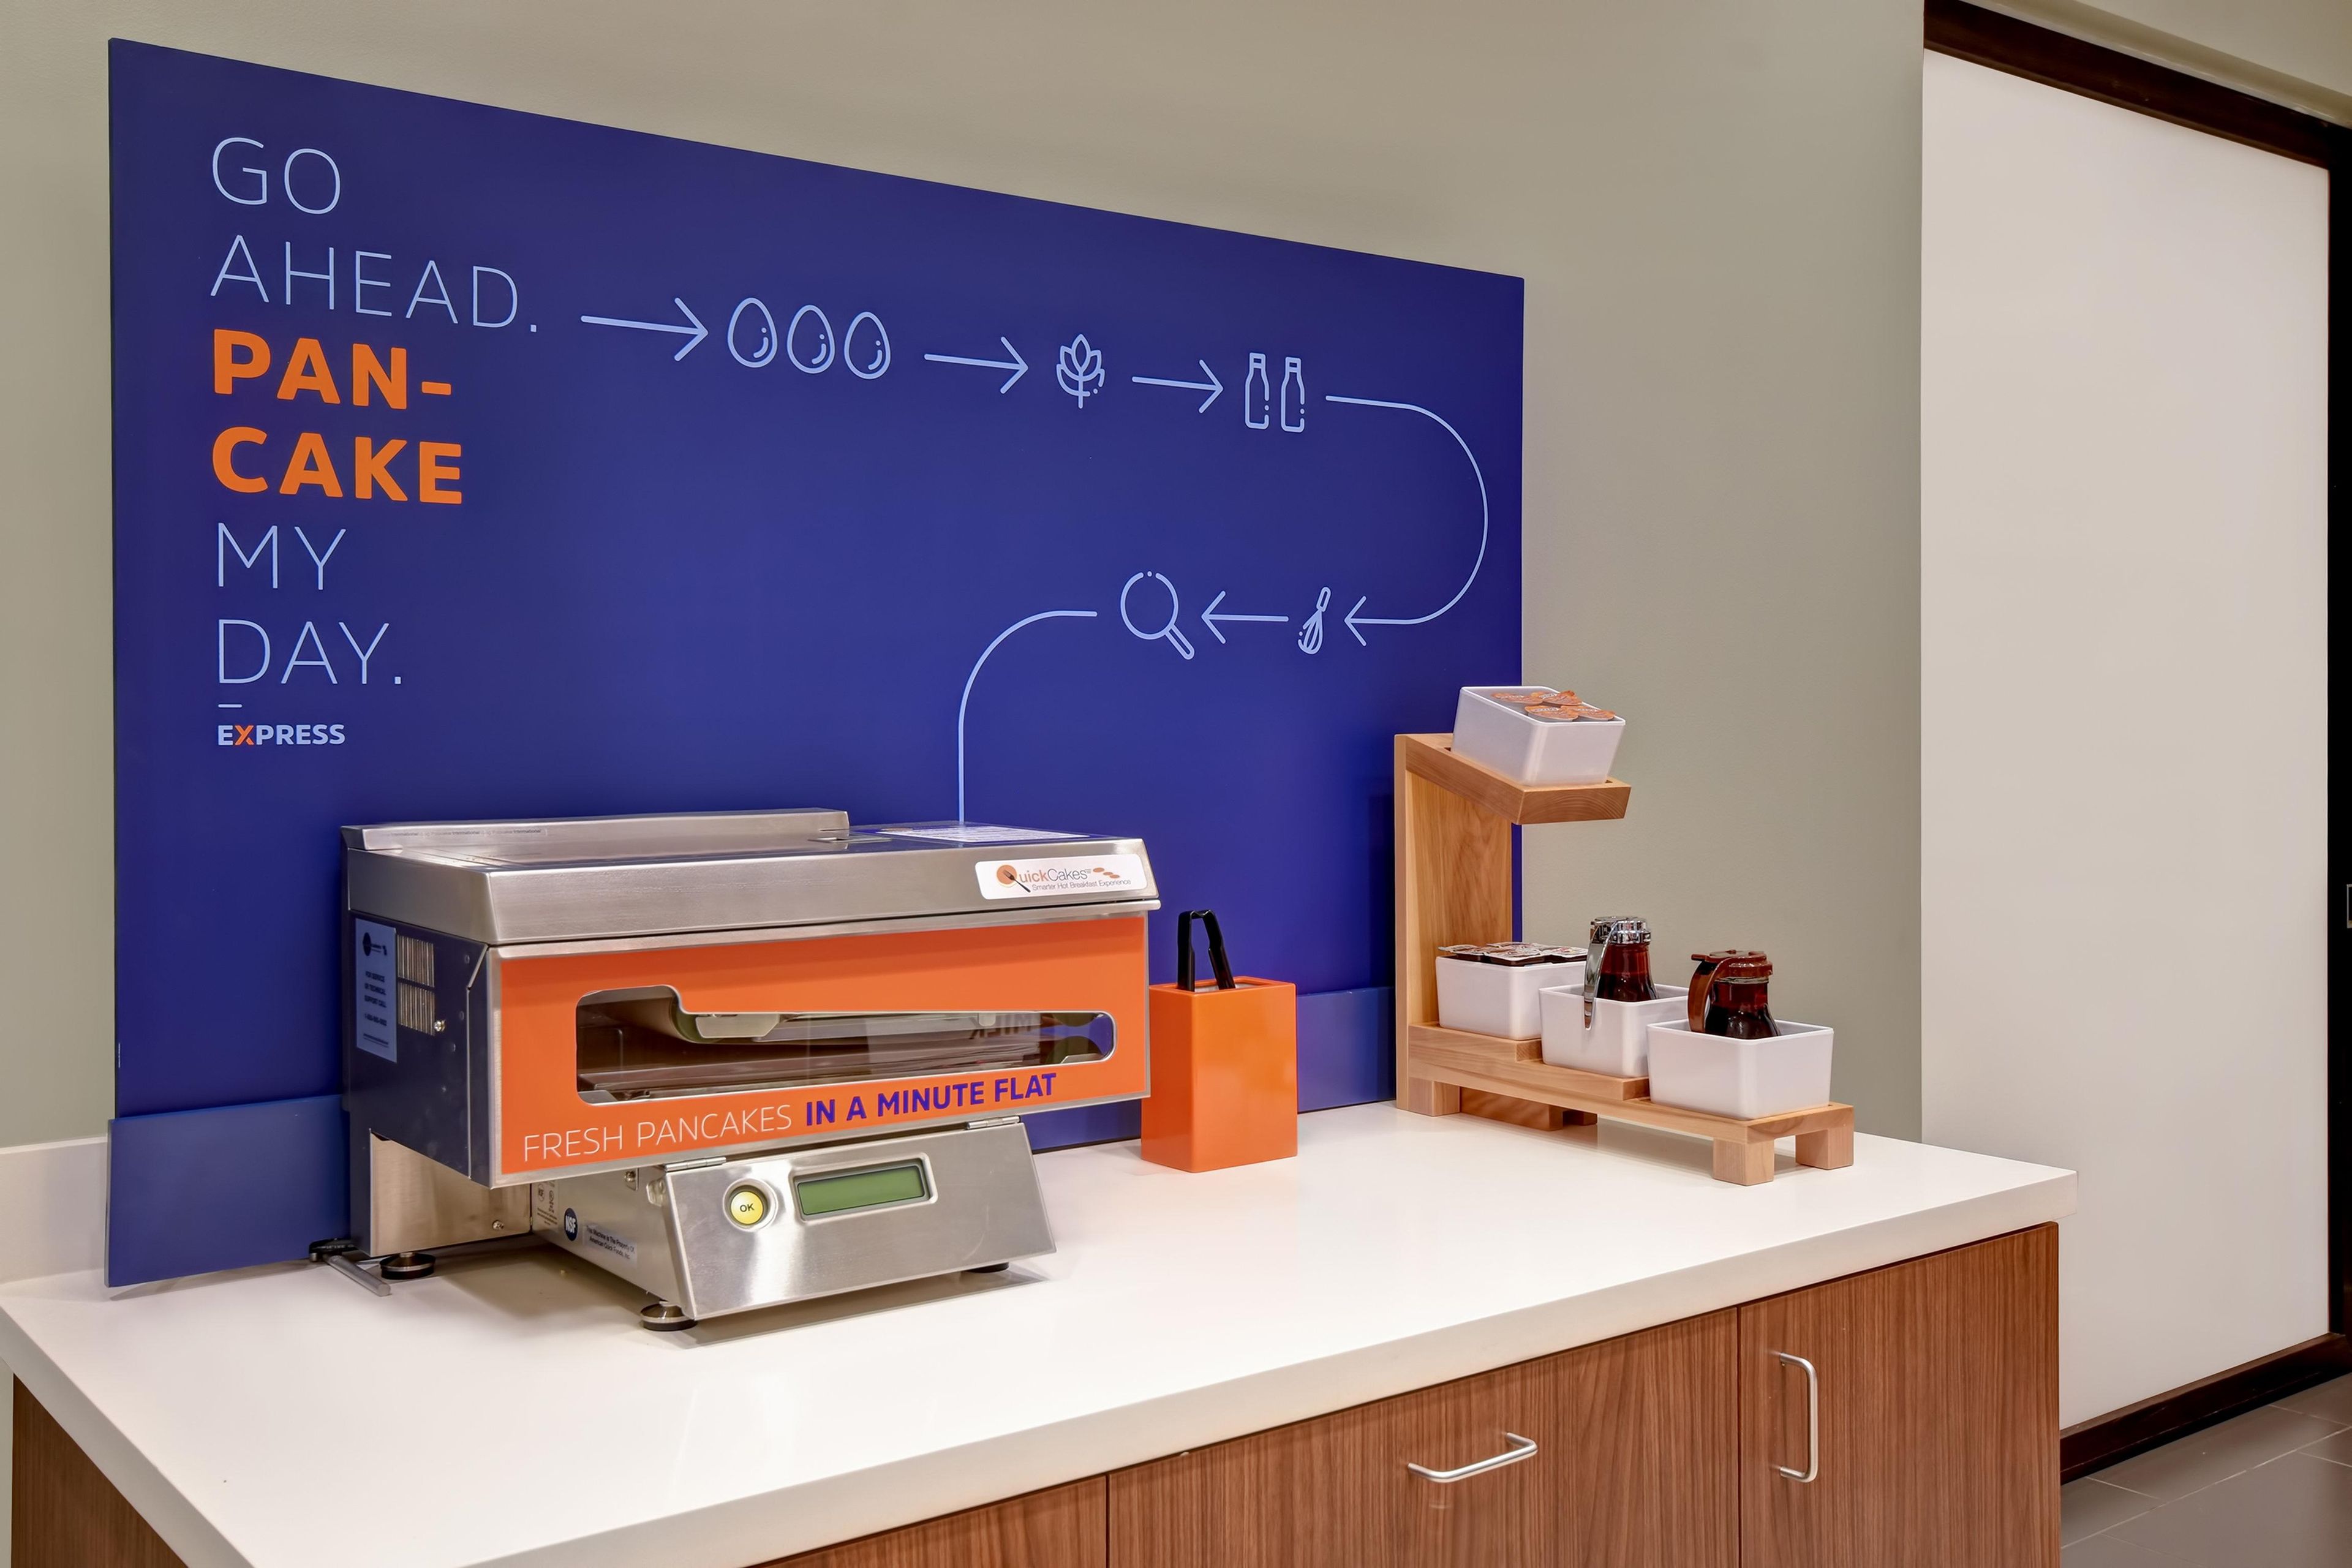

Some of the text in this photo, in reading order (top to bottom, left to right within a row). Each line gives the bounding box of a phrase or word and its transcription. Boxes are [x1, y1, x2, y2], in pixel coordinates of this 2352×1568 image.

[212, 137, 341, 214] GO
[210, 235, 537, 333] AHEAD.
[214, 329, 451, 410] PAN-
[213, 426, 462, 504] CAKE
[218, 522, 346, 590] MY
[219, 619, 401, 685] DAY.
[218, 724, 345, 745] EXPRESS
[1099, 879, 1132, 888] Experience
[524, 1073, 1057, 1162] FRESH PANCAKES IN A MINUTE FLAT
[565, 1215, 576, 1234] NSF
[740, 1203, 755, 1212] OK
